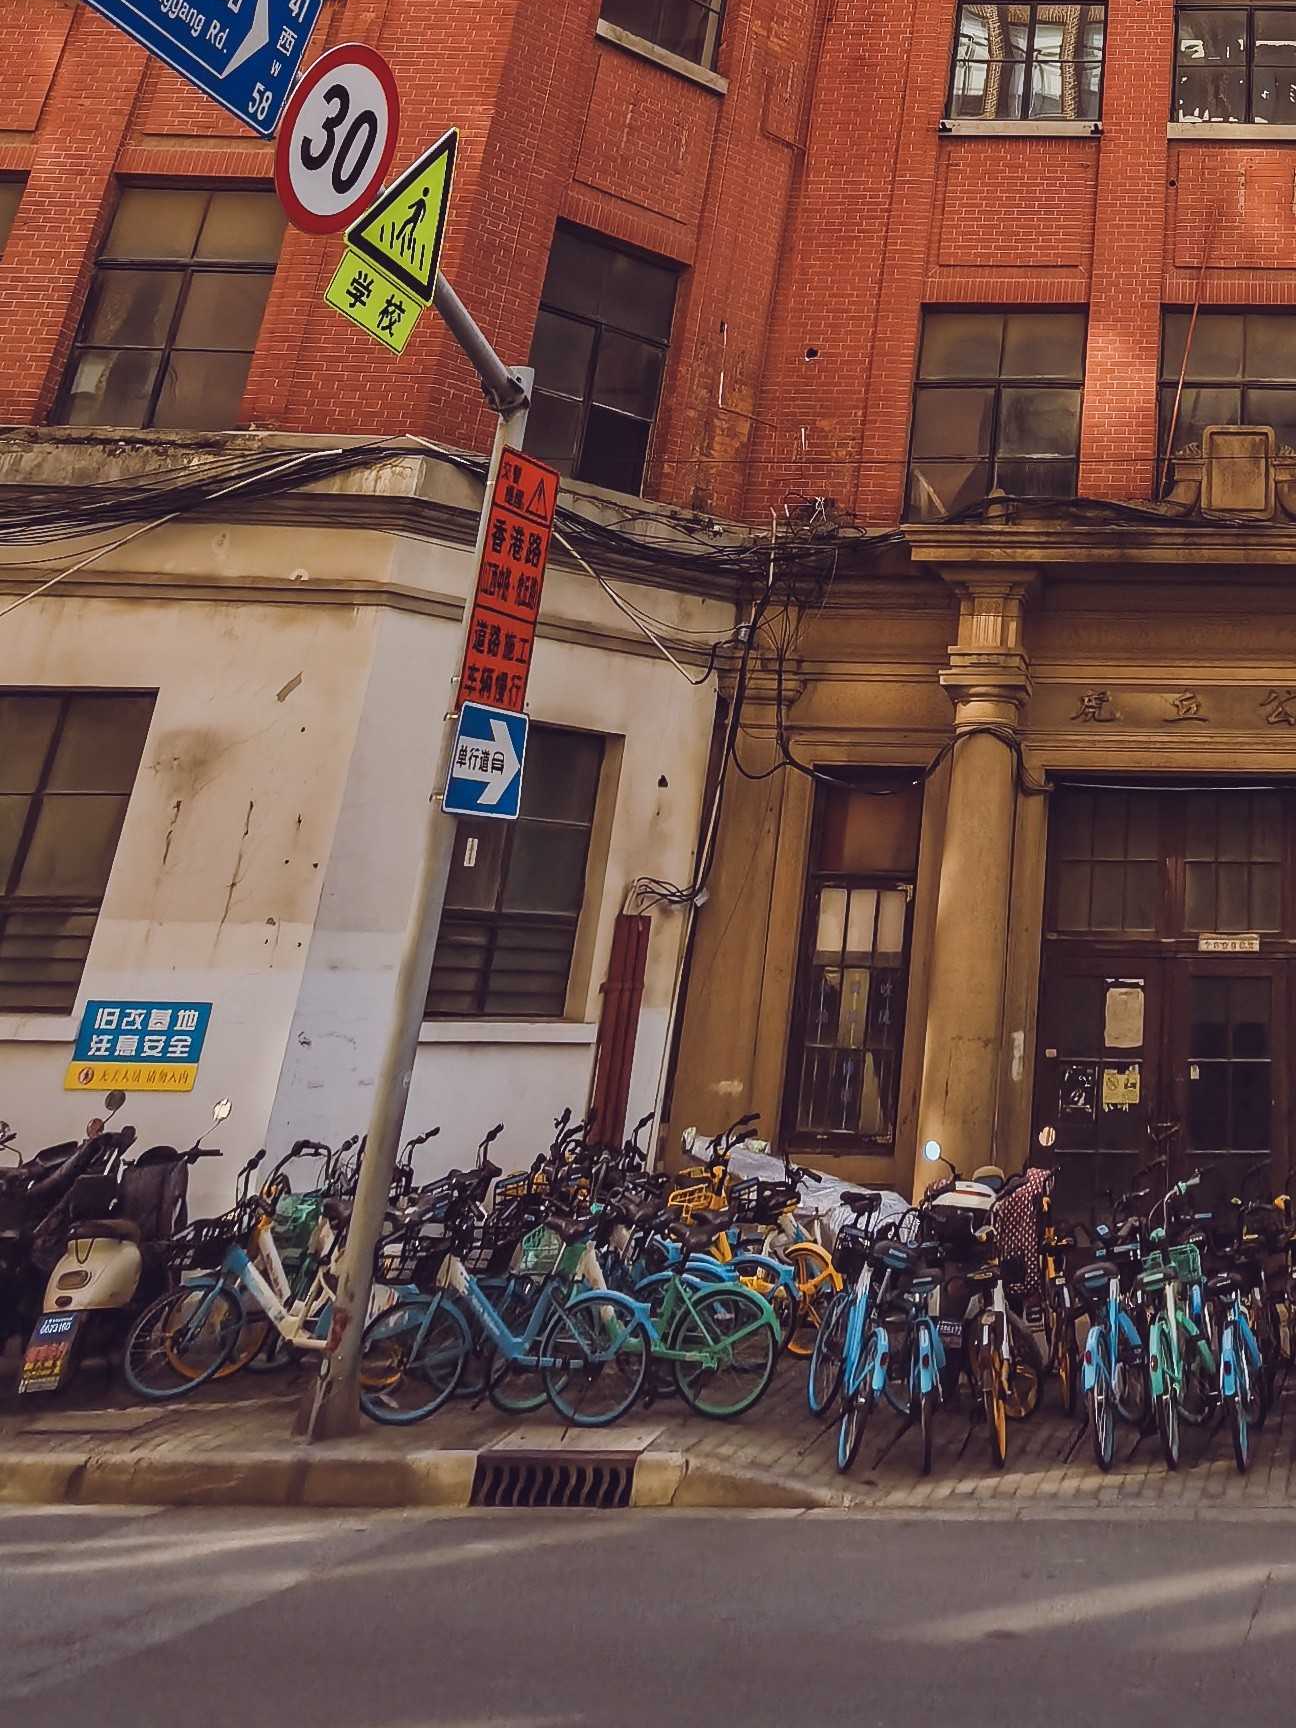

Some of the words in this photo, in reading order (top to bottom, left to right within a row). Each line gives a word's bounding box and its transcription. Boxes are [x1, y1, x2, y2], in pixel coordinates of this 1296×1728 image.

[207, 19, 228, 54] Rd.
[276, 25, 297, 57] 西
[270, 59, 282, 78] W
[248, 81, 274, 122] 58
[300, 83, 378, 194] 30
[345, 270, 406, 338] 学校
[491, 518, 542, 569] 香港路
[456, 744, 491, 773] 单行道
[94, 1007, 199, 1031] 旧改基地
[88, 1034, 193, 1057] 注意安全
